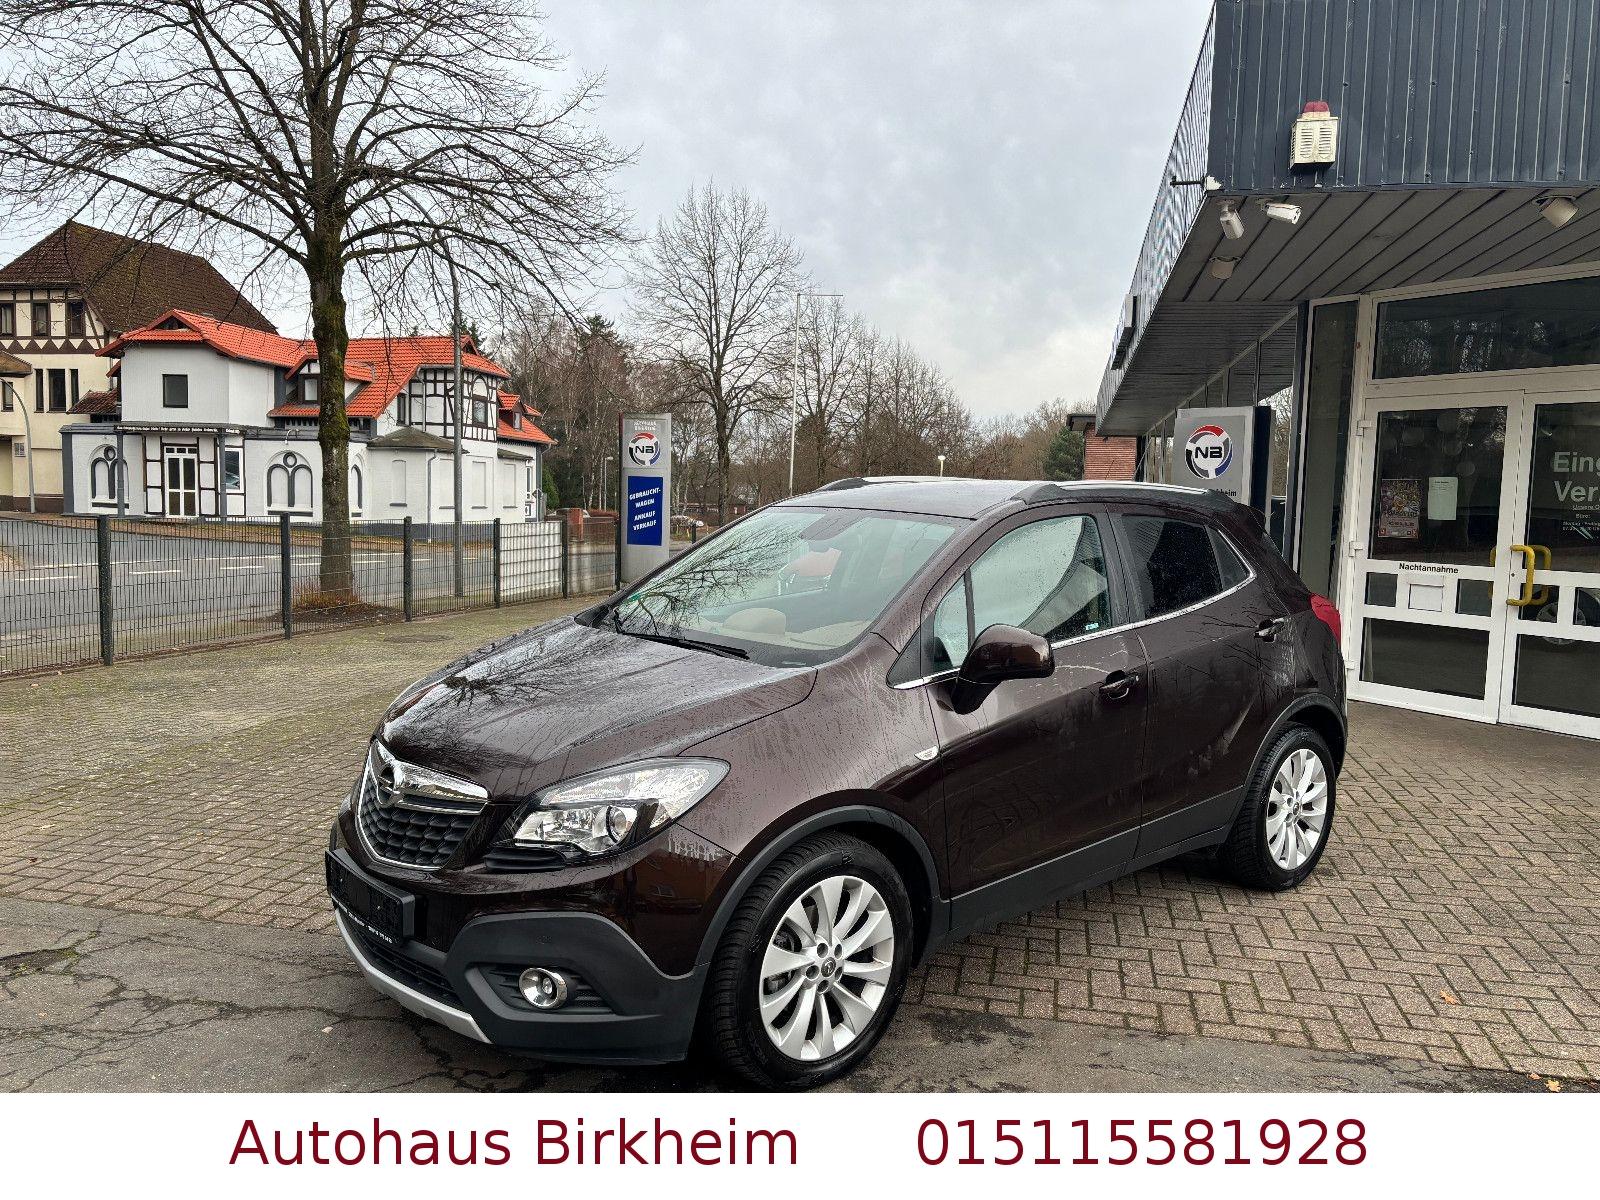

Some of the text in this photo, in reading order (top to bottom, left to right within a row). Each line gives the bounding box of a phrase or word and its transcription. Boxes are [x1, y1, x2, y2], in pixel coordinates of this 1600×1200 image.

[635, 445, 655, 453] NB
[1194, 446, 1223, 458] NB
[634, 510, 656, 521] ANKAUF
[632, 519, 657, 531] VERKAUF
[1399, 562, 1459, 574] Nachtannahme
